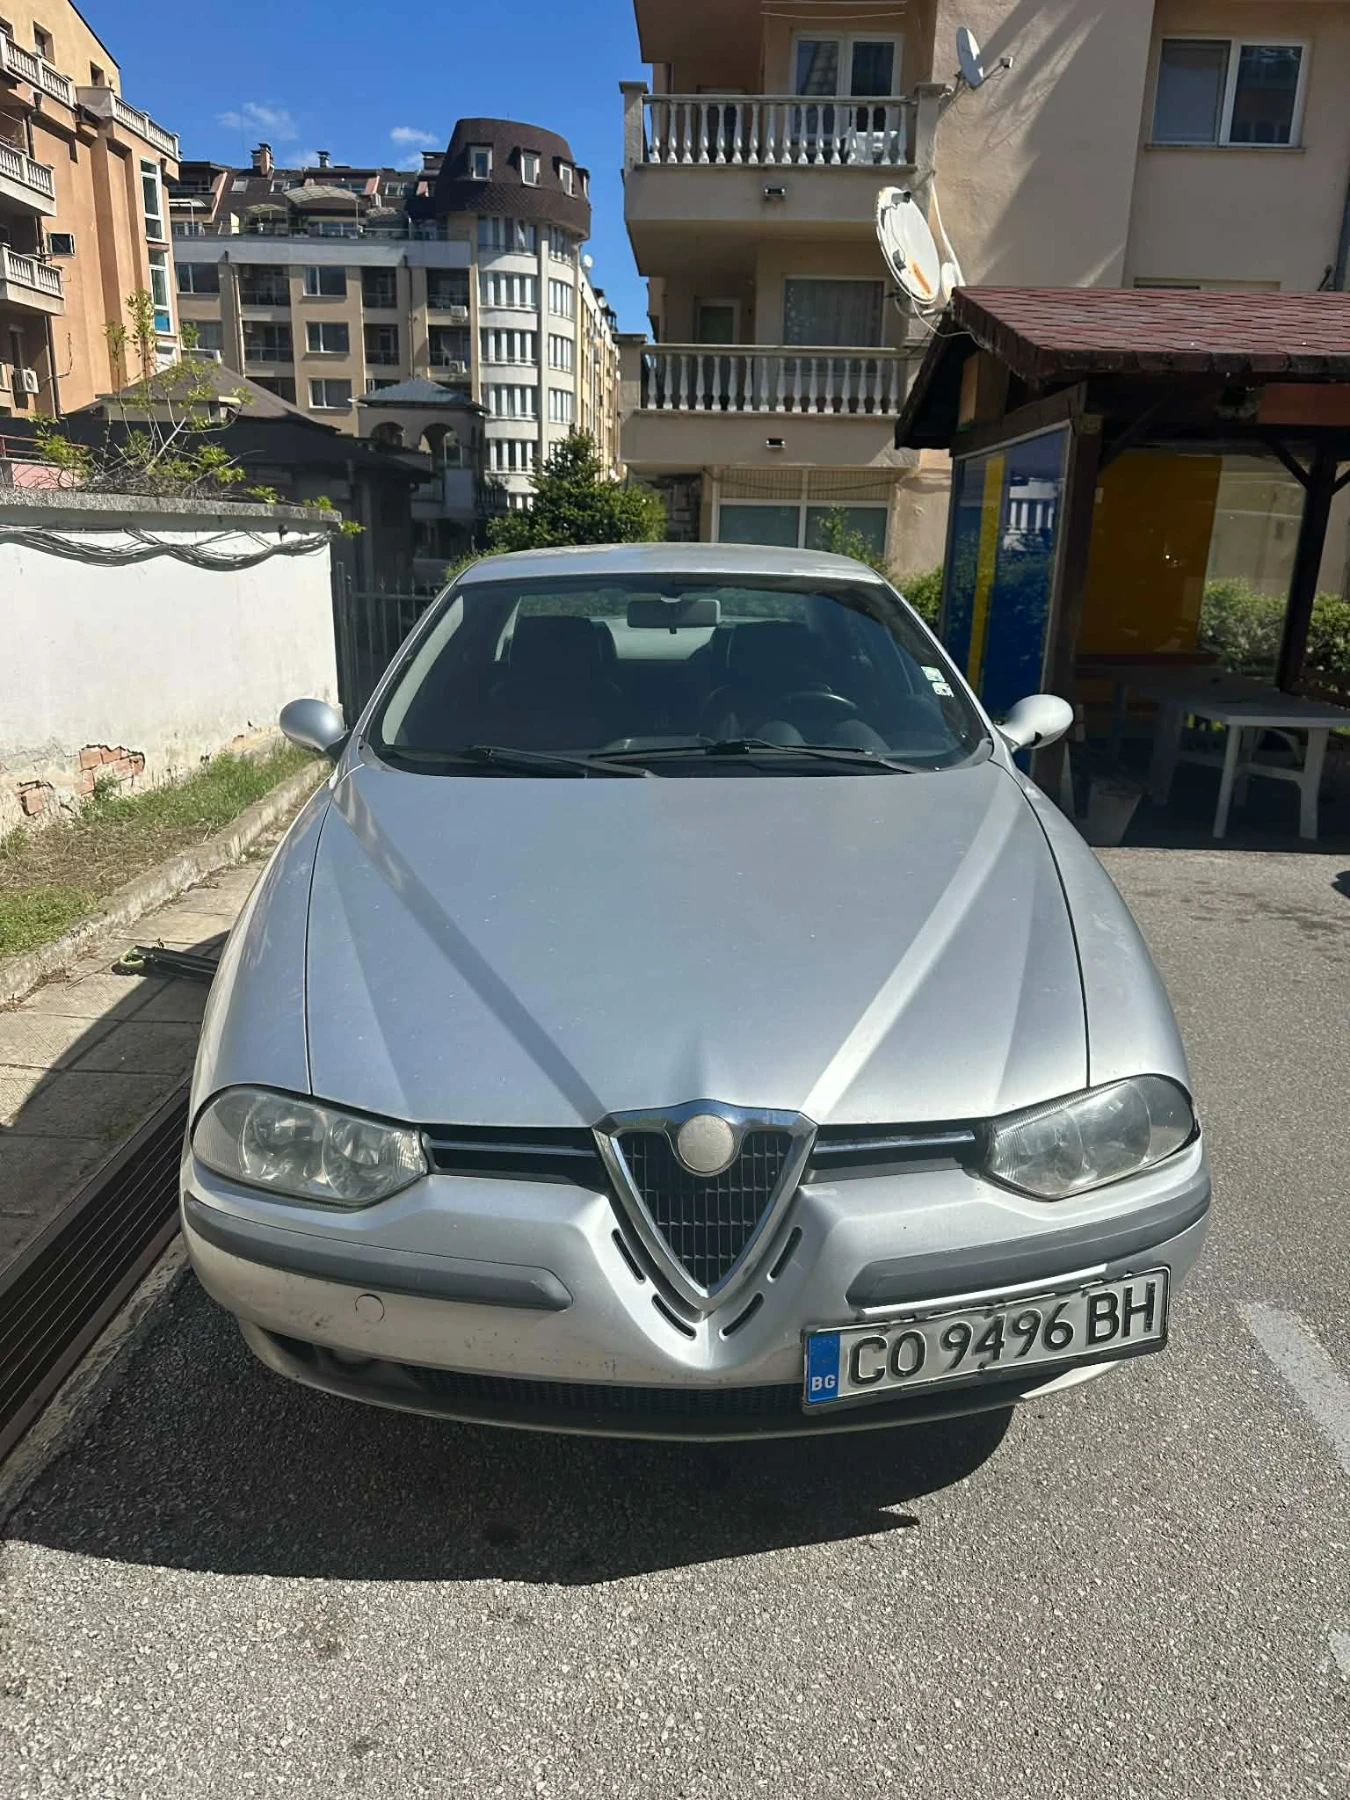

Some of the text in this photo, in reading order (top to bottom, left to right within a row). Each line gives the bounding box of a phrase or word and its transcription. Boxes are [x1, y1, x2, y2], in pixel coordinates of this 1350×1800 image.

[850, 1282, 1156, 1385] CO 9496 BH
[810, 1374, 836, 1392] BG
